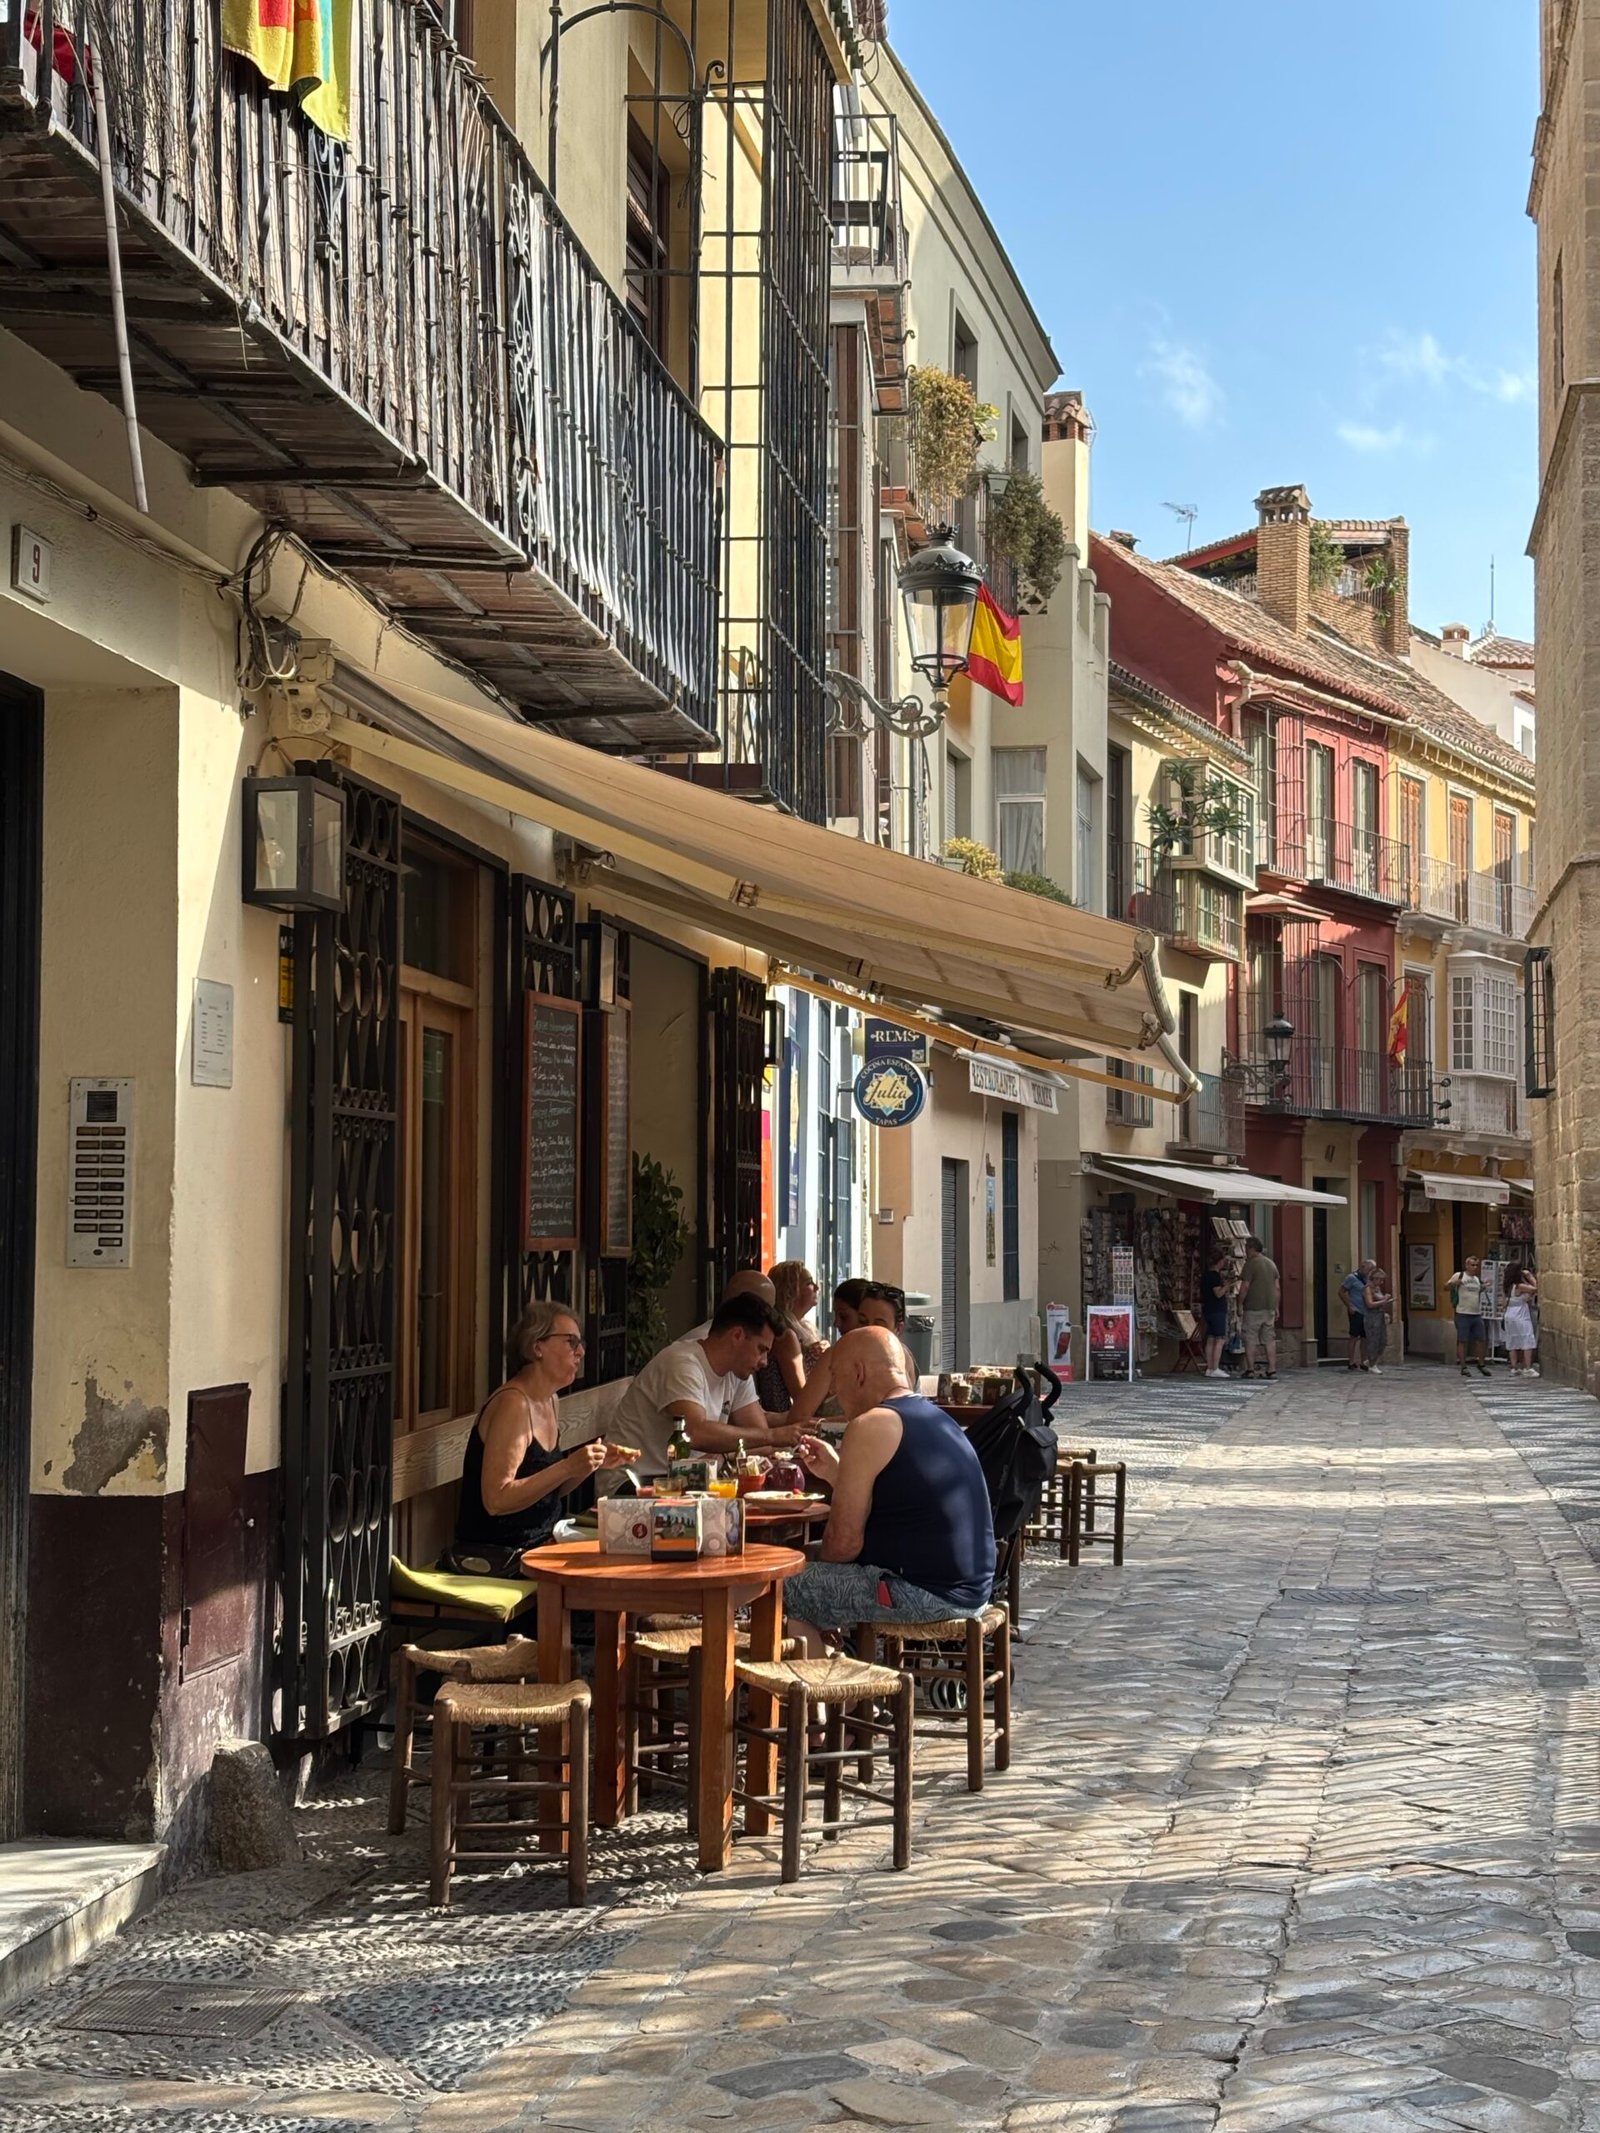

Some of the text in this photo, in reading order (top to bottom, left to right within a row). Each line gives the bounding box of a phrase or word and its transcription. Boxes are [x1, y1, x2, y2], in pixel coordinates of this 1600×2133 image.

[32, 543, 41, 584] 9
[860, 1059, 919, 1084] COCINA ESPAÑOLA
[971, 1063, 1018, 1098] RESTAURANTE
[863, 1078, 907, 1104] Julia
[875, 1117, 898, 1127] TAPAS
